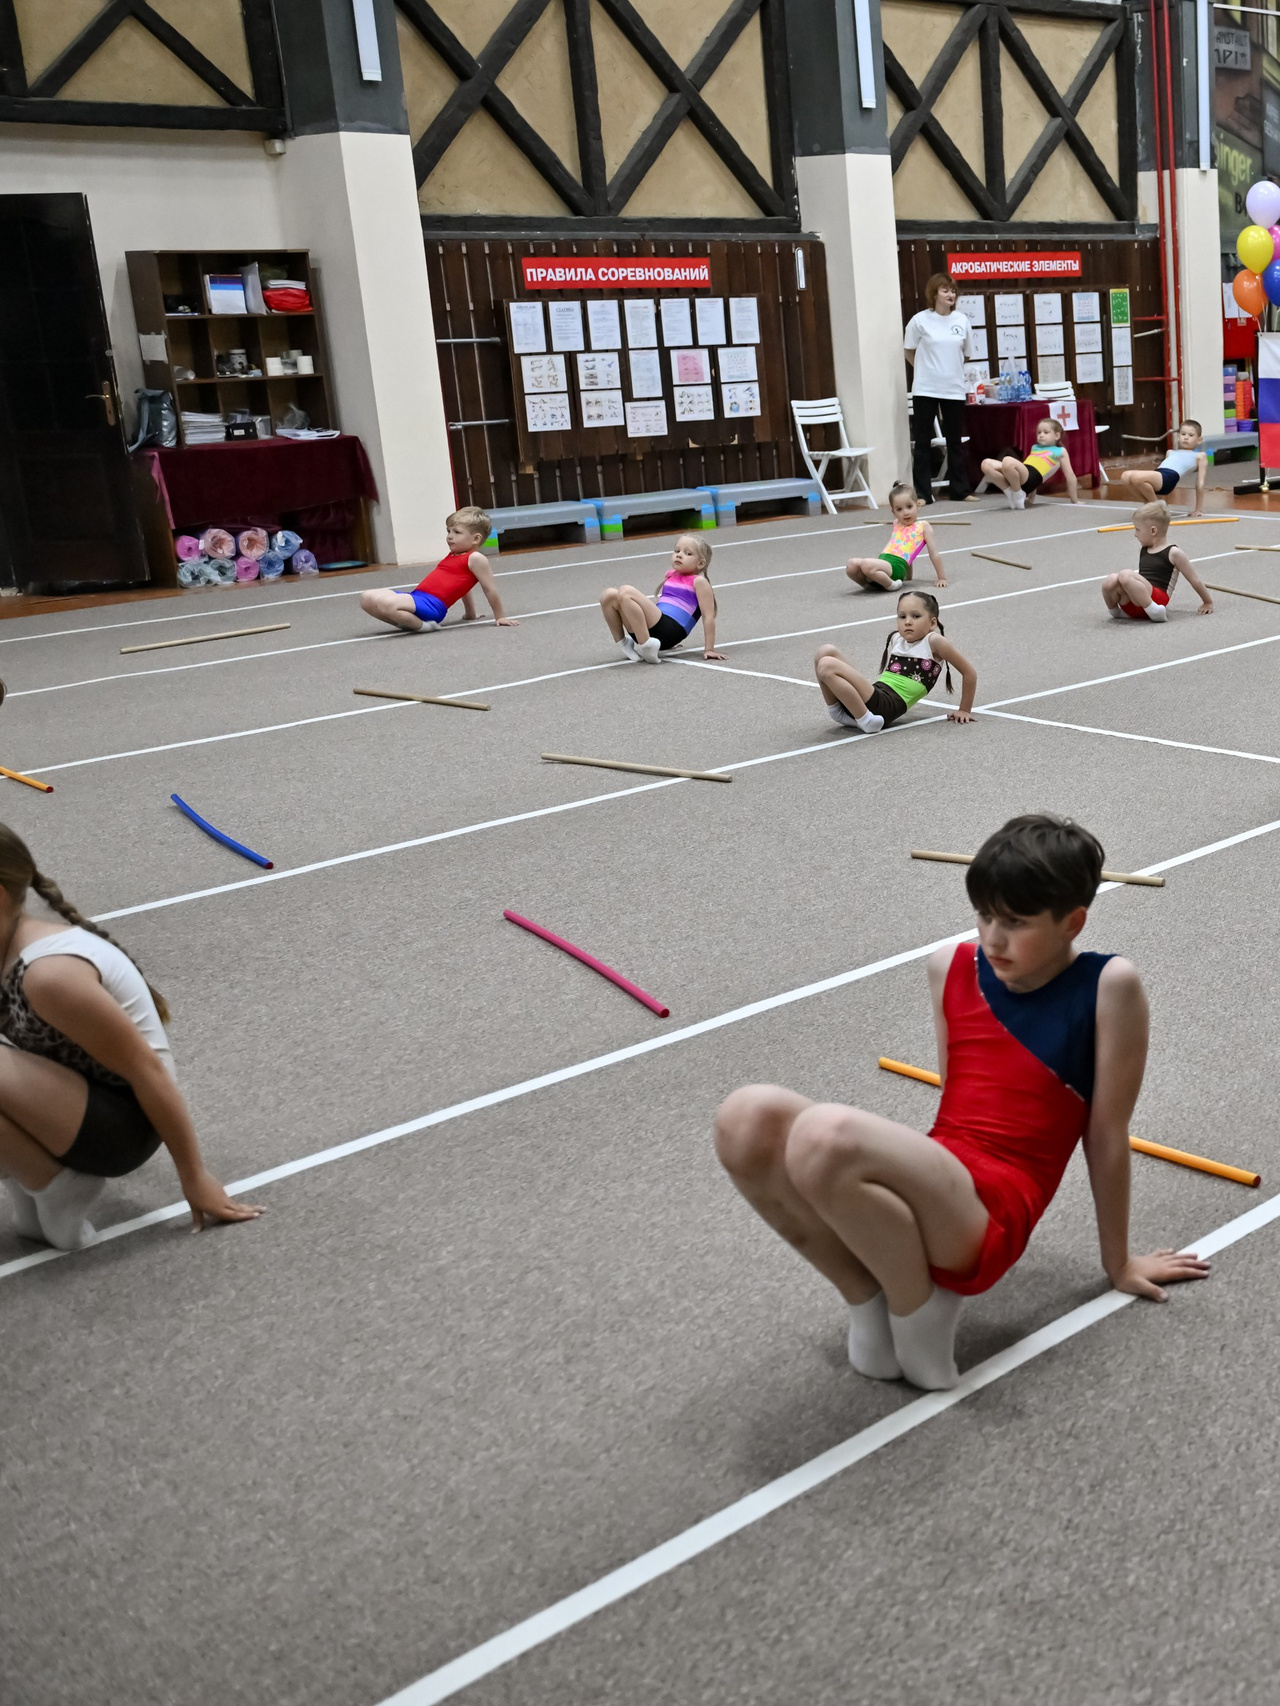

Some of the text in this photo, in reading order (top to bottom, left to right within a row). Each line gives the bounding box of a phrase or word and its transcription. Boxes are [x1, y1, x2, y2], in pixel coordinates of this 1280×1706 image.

[526, 265, 709, 282] ПРАВИЛА СОРЕВНОВАНИЙ
[950, 259, 1079, 274] АКРОБАТИЧЕСКИЕ ЭЛЕМЕНТЫ
